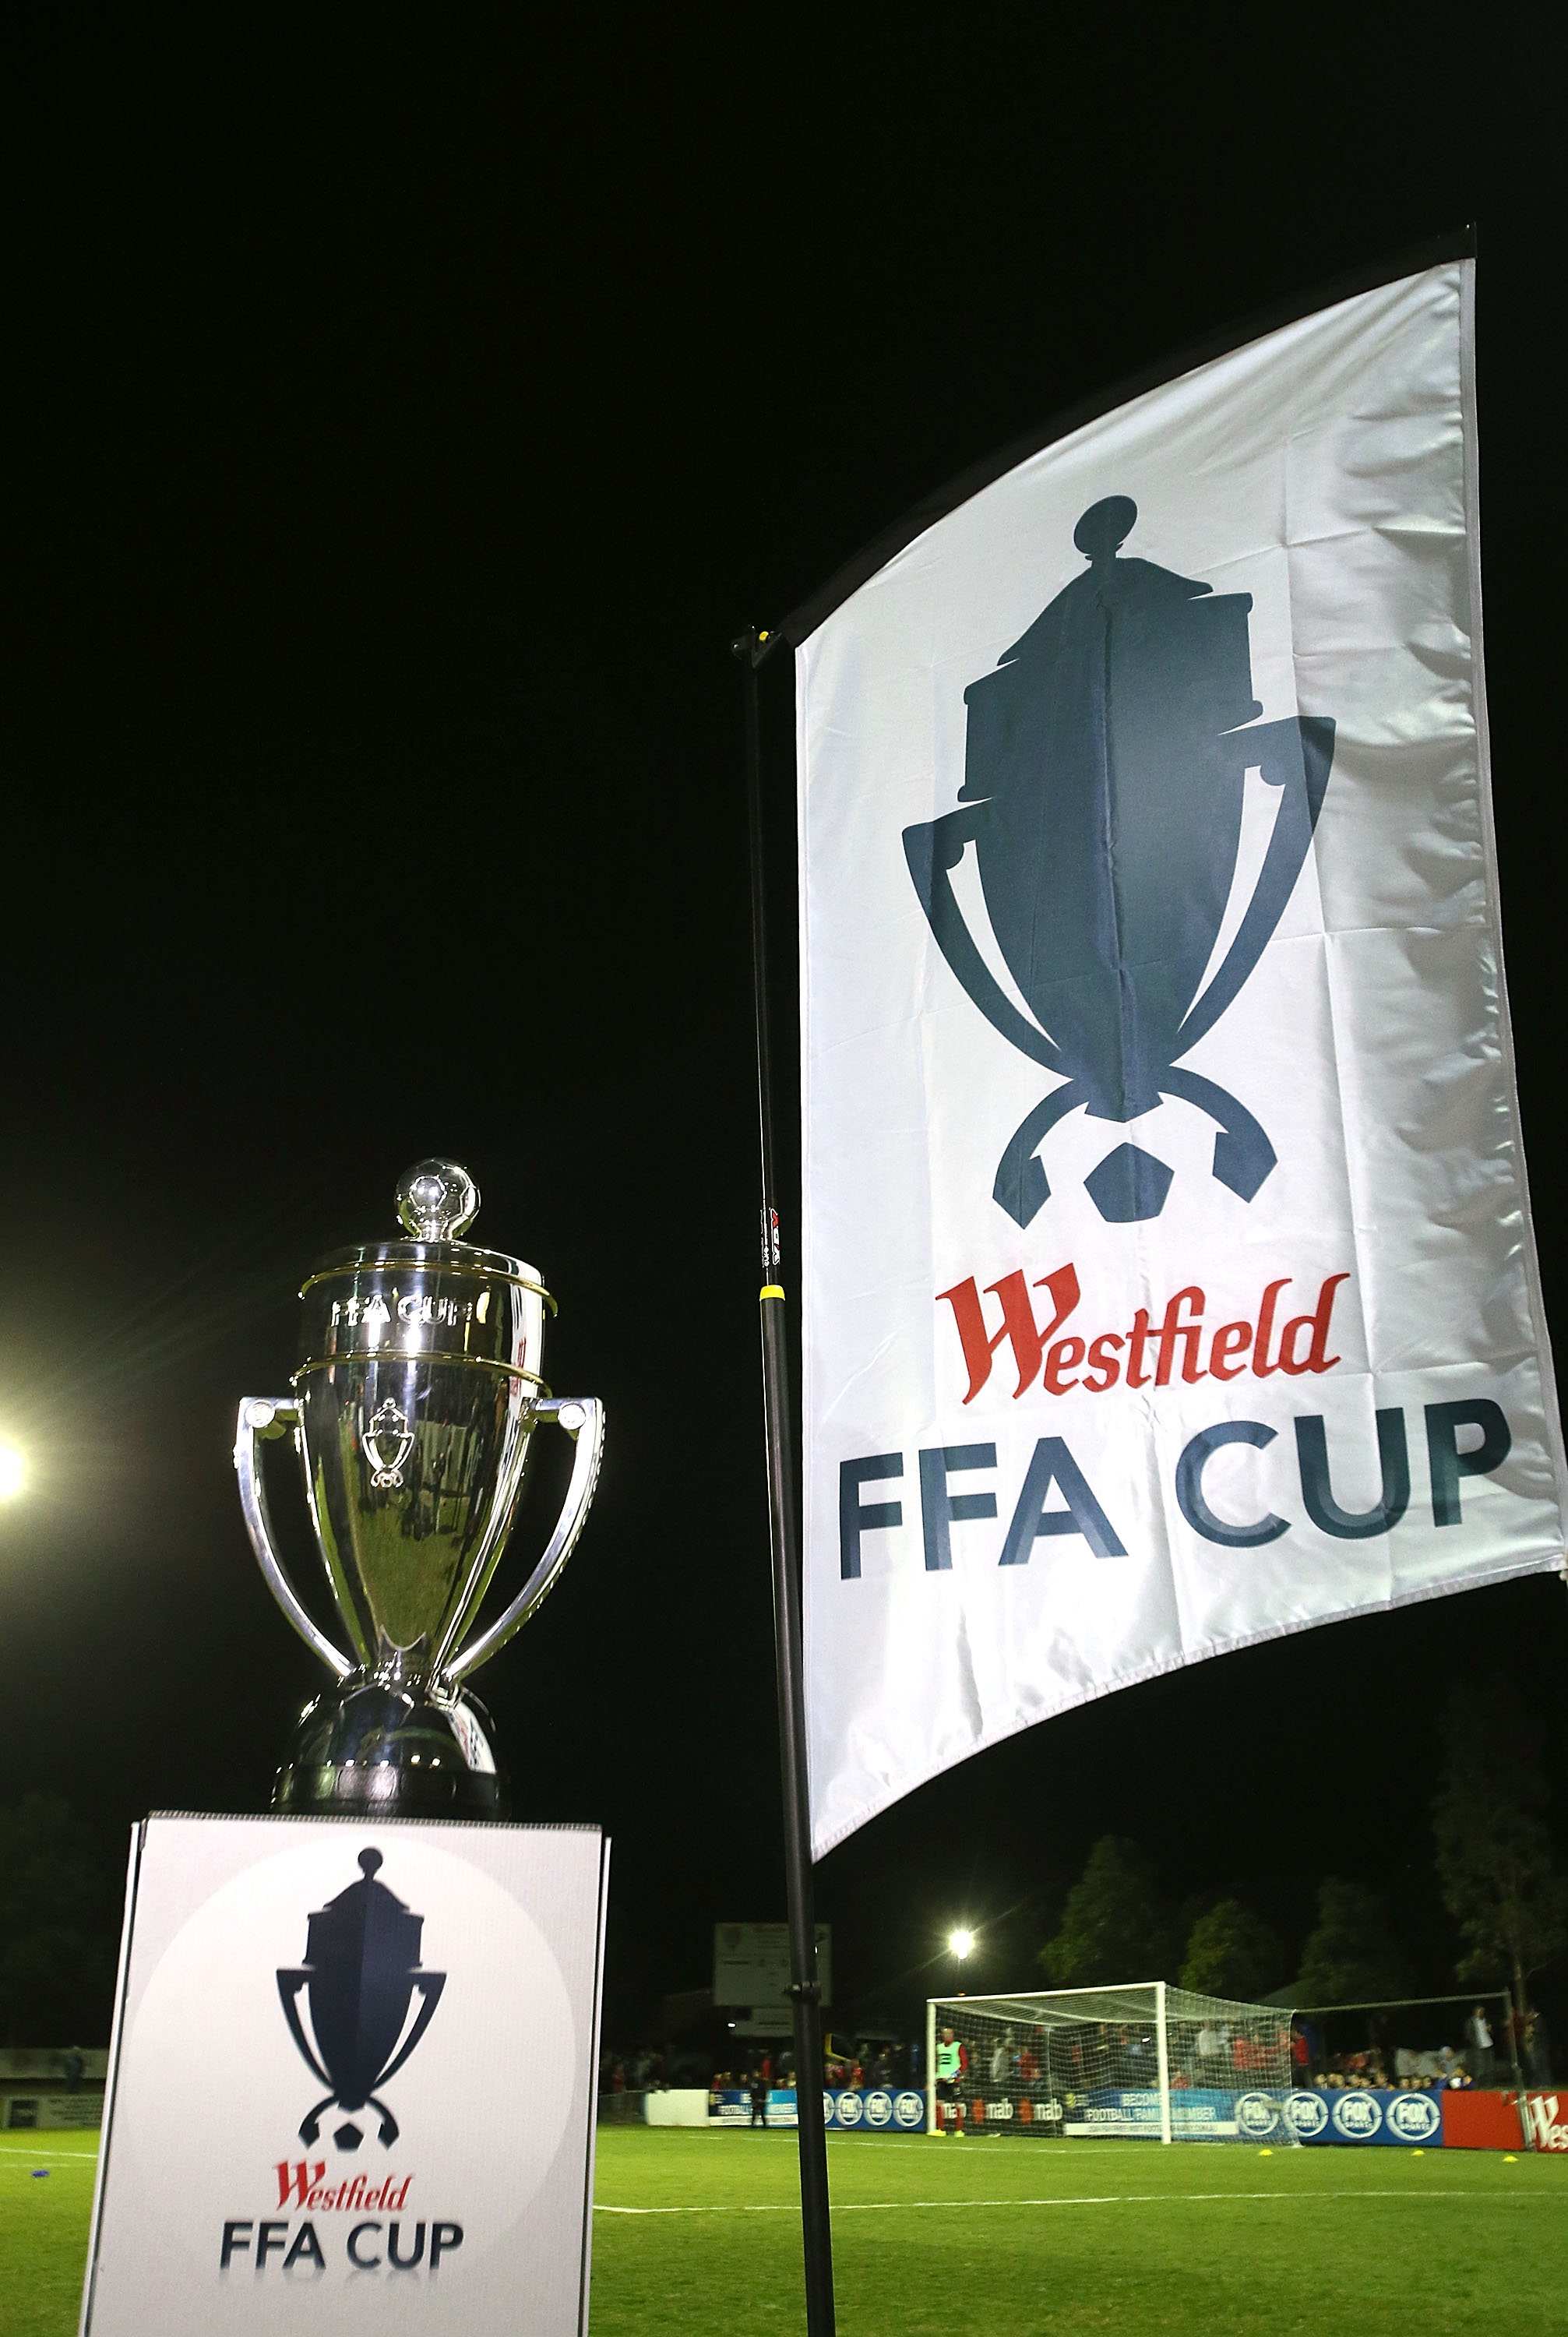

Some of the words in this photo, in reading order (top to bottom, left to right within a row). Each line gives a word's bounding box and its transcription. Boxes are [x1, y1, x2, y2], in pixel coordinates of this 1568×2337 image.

[935, 1262, 1351, 1405] Westfield
[840, 1436, 1129, 1581] FFA
[1175, 1398, 1512, 1548] CUP
[986, 2098, 1013, 2120] nab
[1034, 2098, 1062, 2120] nab
[1084, 2108, 1133, 2121] FOOTBALL
[1291, 2100, 1320, 2120] FOX
[1341, 2101, 1373, 2121] FOX
[1396, 2102, 1430, 2123] FOX
[275, 2159, 413, 2211] Westfield
[220, 2221, 326, 2269] FFA
[347, 2221, 464, 2271] CUP
